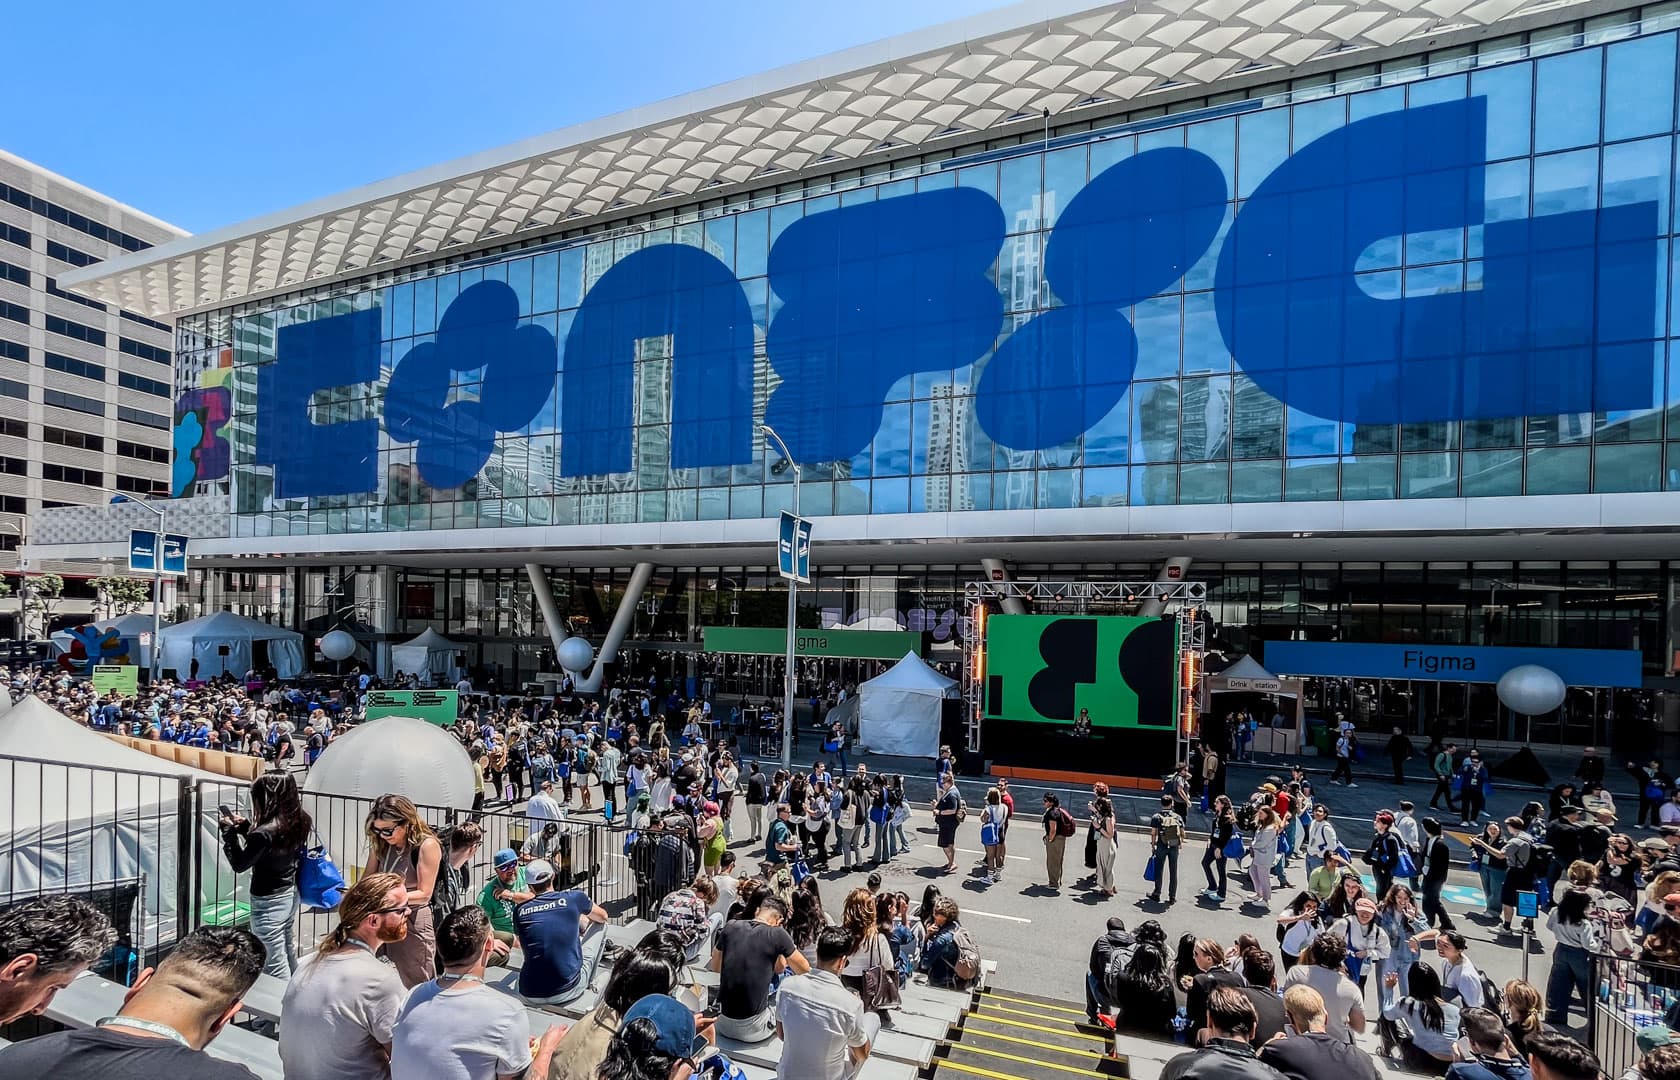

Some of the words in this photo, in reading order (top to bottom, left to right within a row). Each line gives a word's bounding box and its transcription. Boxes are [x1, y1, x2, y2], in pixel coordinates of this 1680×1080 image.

[795, 637, 828, 650] gma
[1404, 650, 1475, 673] Figma
[1230, 680, 1248, 688] Drink
[1255, 681, 1278, 689] station
[519, 901, 556, 916] Amazon
[558, 898, 568, 906] Q
